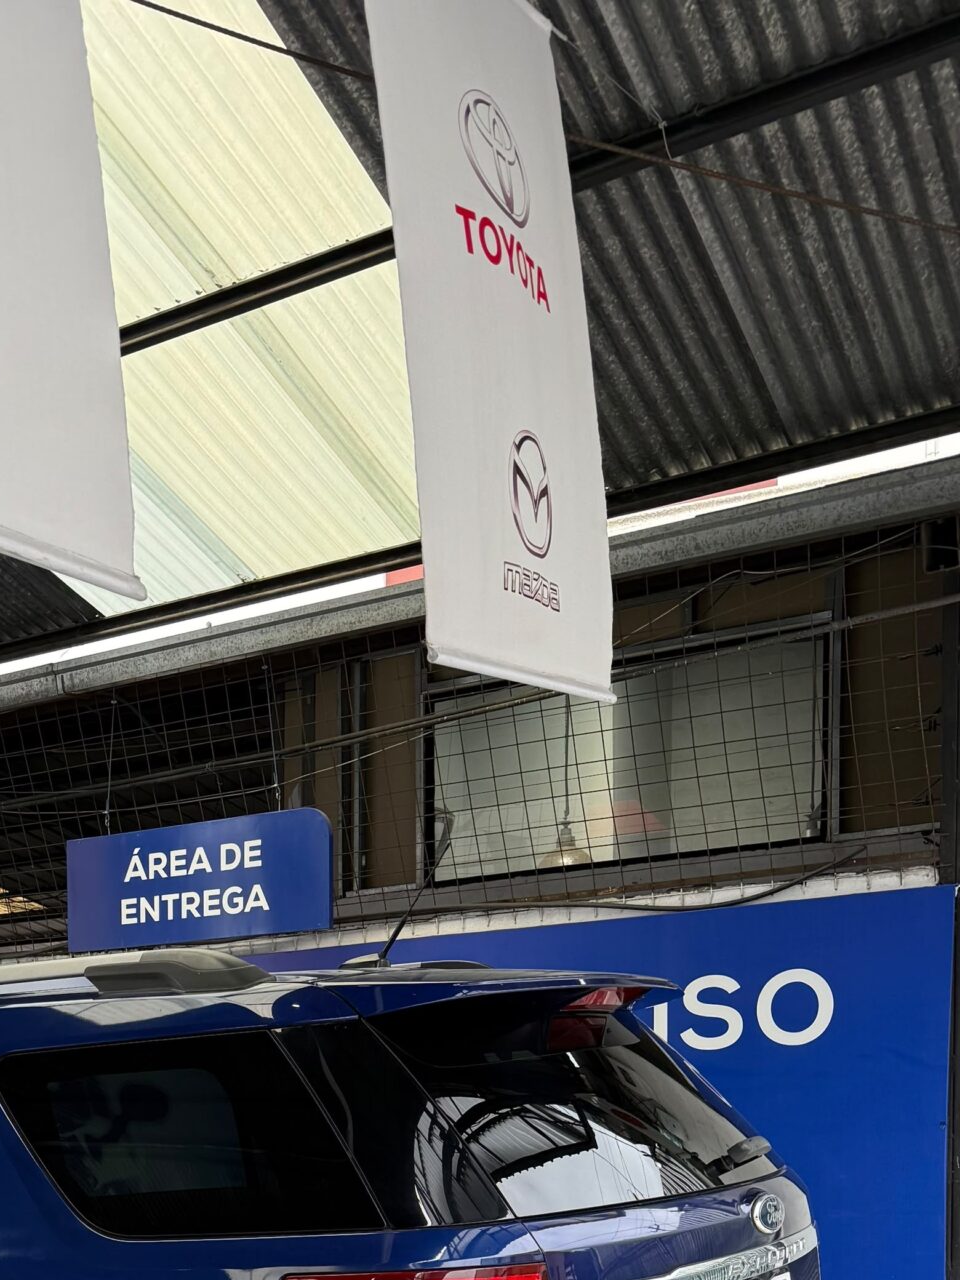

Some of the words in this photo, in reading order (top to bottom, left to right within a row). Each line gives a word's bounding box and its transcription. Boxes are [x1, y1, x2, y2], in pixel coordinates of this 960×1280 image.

[454, 203, 551, 314] TOYOTA
[123, 847, 213, 883] ÁREA
[220, 839, 262, 872] DE
[120, 883, 271, 925] ENTREGA
